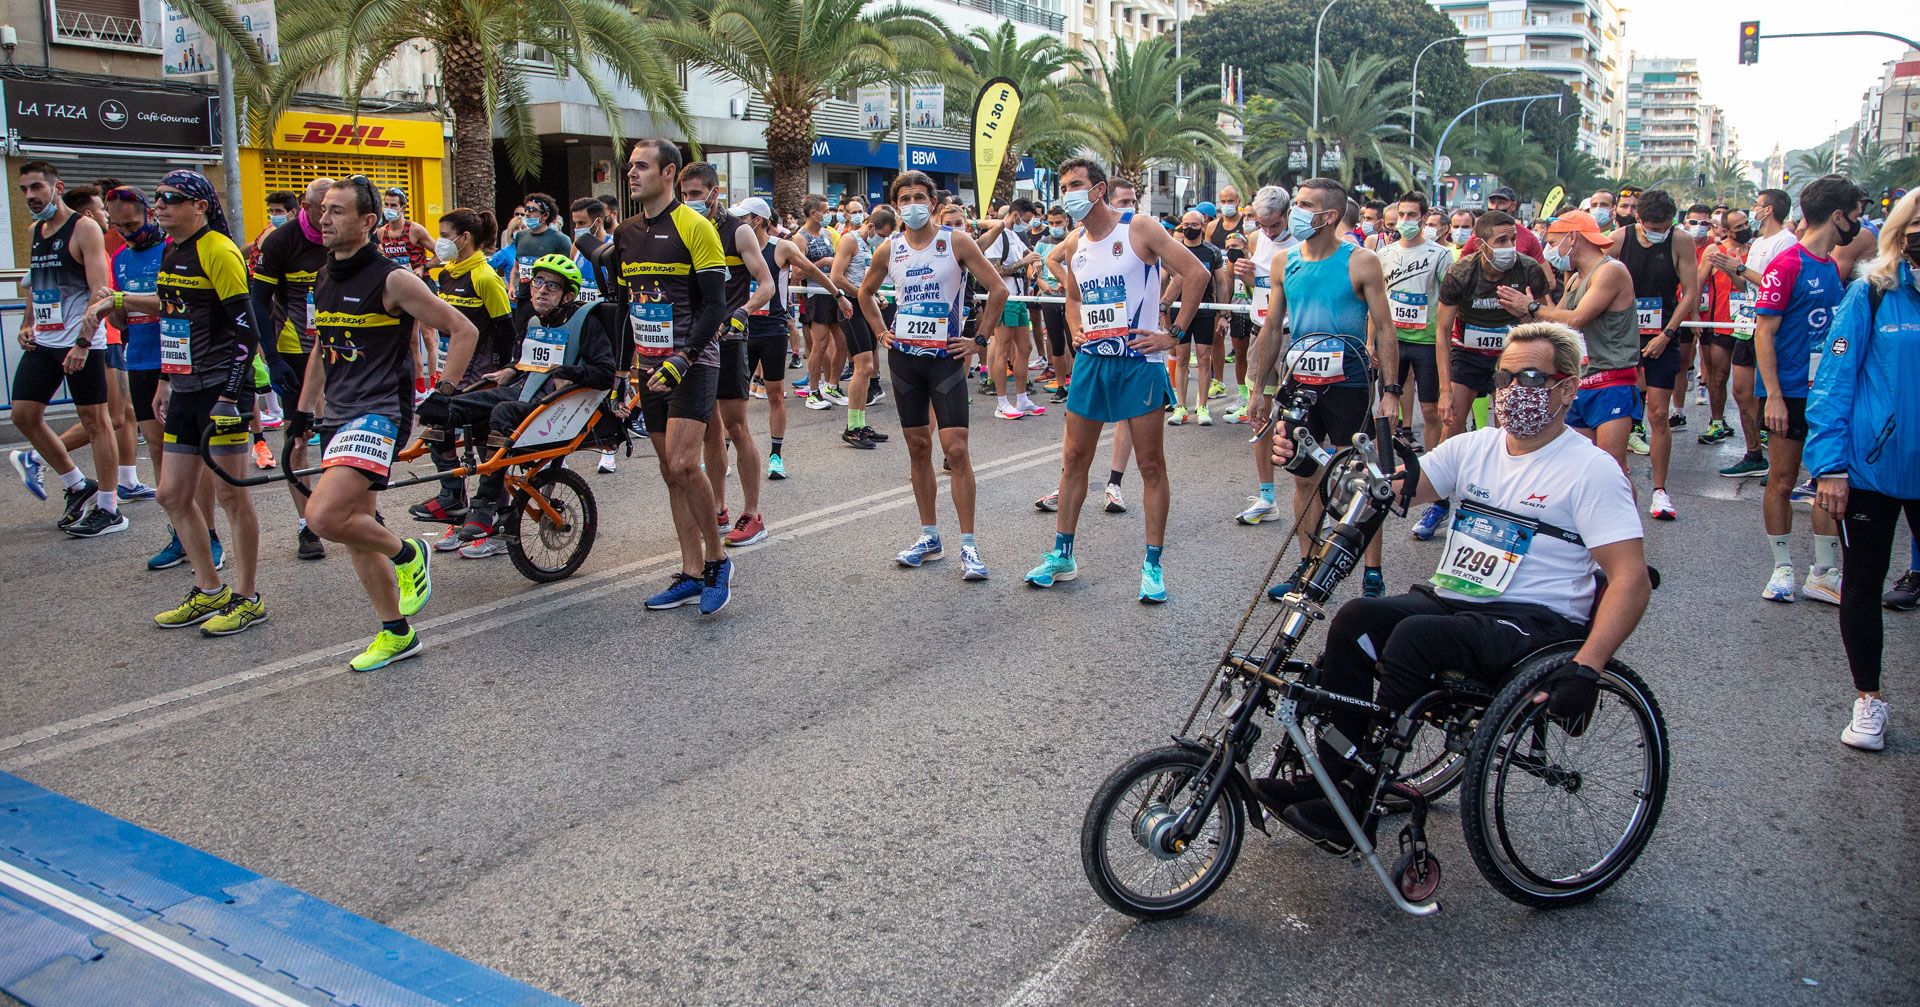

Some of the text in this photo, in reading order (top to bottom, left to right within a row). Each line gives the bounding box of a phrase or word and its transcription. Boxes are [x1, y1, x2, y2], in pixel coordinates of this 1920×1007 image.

[18, 101, 88, 122] LA TAZA
[982, 89, 1009, 139] 1 h 30 m
[160, 114, 200, 127] Gourmet
[303, 121, 385, 148] DHL
[812, 142, 831, 156] BVA
[912, 151, 937, 165] BBVA
[580, 291, 596, 302] 1815
[905, 292, 940, 302] ALICANTE
[35, 307, 51, 320] 447
[1087, 308, 1115, 325] 1640
[1395, 307, 1418, 319] 1543
[1637, 313, 1651, 325] 14
[341, 316, 367, 325] RUEDAS
[907, 321, 936, 335] 2124
[644, 335, 670, 343] RUEDAS
[1476, 336, 1503, 348] 1478
[166, 351, 188, 361] RUEDAS
[532, 346, 551, 362] 195
[1300, 357, 1330, 372] 2017
[341, 433, 382, 446] ZANCADAS
[329, 445, 388, 461] SOBRE RUEDAS
[1520, 500, 1546, 509] HEALTH
[1452, 545, 1499, 577] 1299
[1462, 573, 1484, 584] MTNEZ
[1329, 692, 1373, 708] STRICKER
